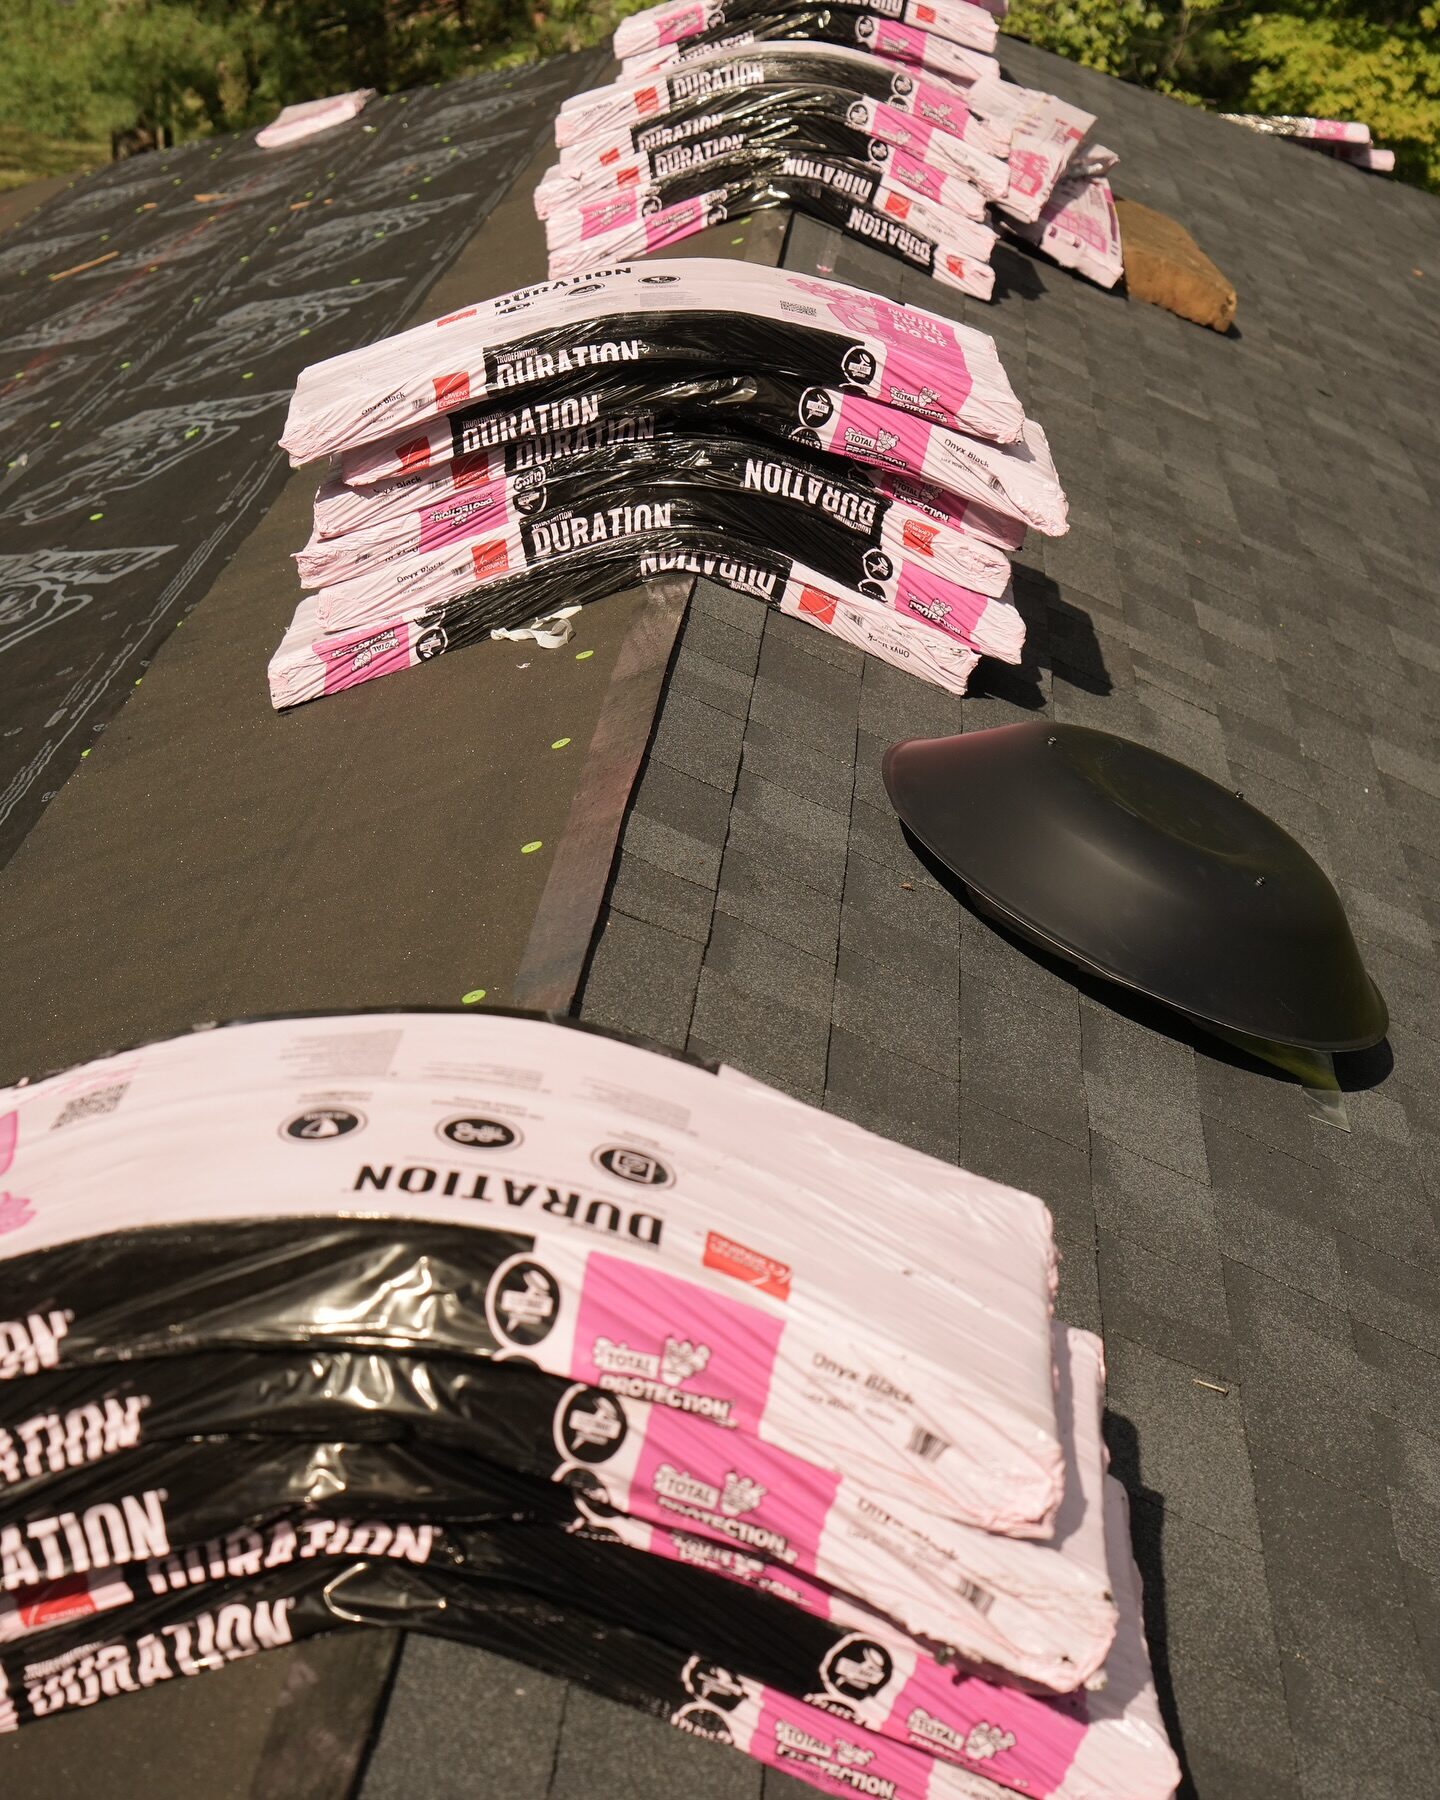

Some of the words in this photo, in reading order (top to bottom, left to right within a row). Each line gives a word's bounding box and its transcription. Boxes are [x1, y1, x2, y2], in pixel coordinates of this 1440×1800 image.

[673, 62, 765, 98] DURATION
[638, 113, 724, 152] DURATION
[655, 133, 747, 176] DURATION
[849, 206, 932, 262] DURATION
[494, 267, 633, 308] DURATION
[497, 339, 640, 389] DURATION
[463, 395, 599, 454] DURATION
[515, 415, 655, 473] DURATION
[850, 433, 874, 448] TOTAL
[944, 438, 967, 455] Onyx
[967, 451, 990, 468] Black
[744, 458, 877, 527] DURATION
[897, 481, 918, 495] TOTAL
[531, 503, 673, 557] DURATION
[371, 639, 395, 653] TOTAL
[890, 643, 910, 658] Onyx
[353, 1164, 664, 1249] DURATION
[607, 1352, 653, 1373] TOTAL
[600, 1374, 732, 1419] PROTECTION
[667, 1478, 712, 1504] TOTAL
[0, 1490, 170, 1590] ATION
[658, 1496, 788, 1552] PROTECTION
[147, 1519, 434, 1595] DURATION
[27, 1598, 293, 1717] DURATION
